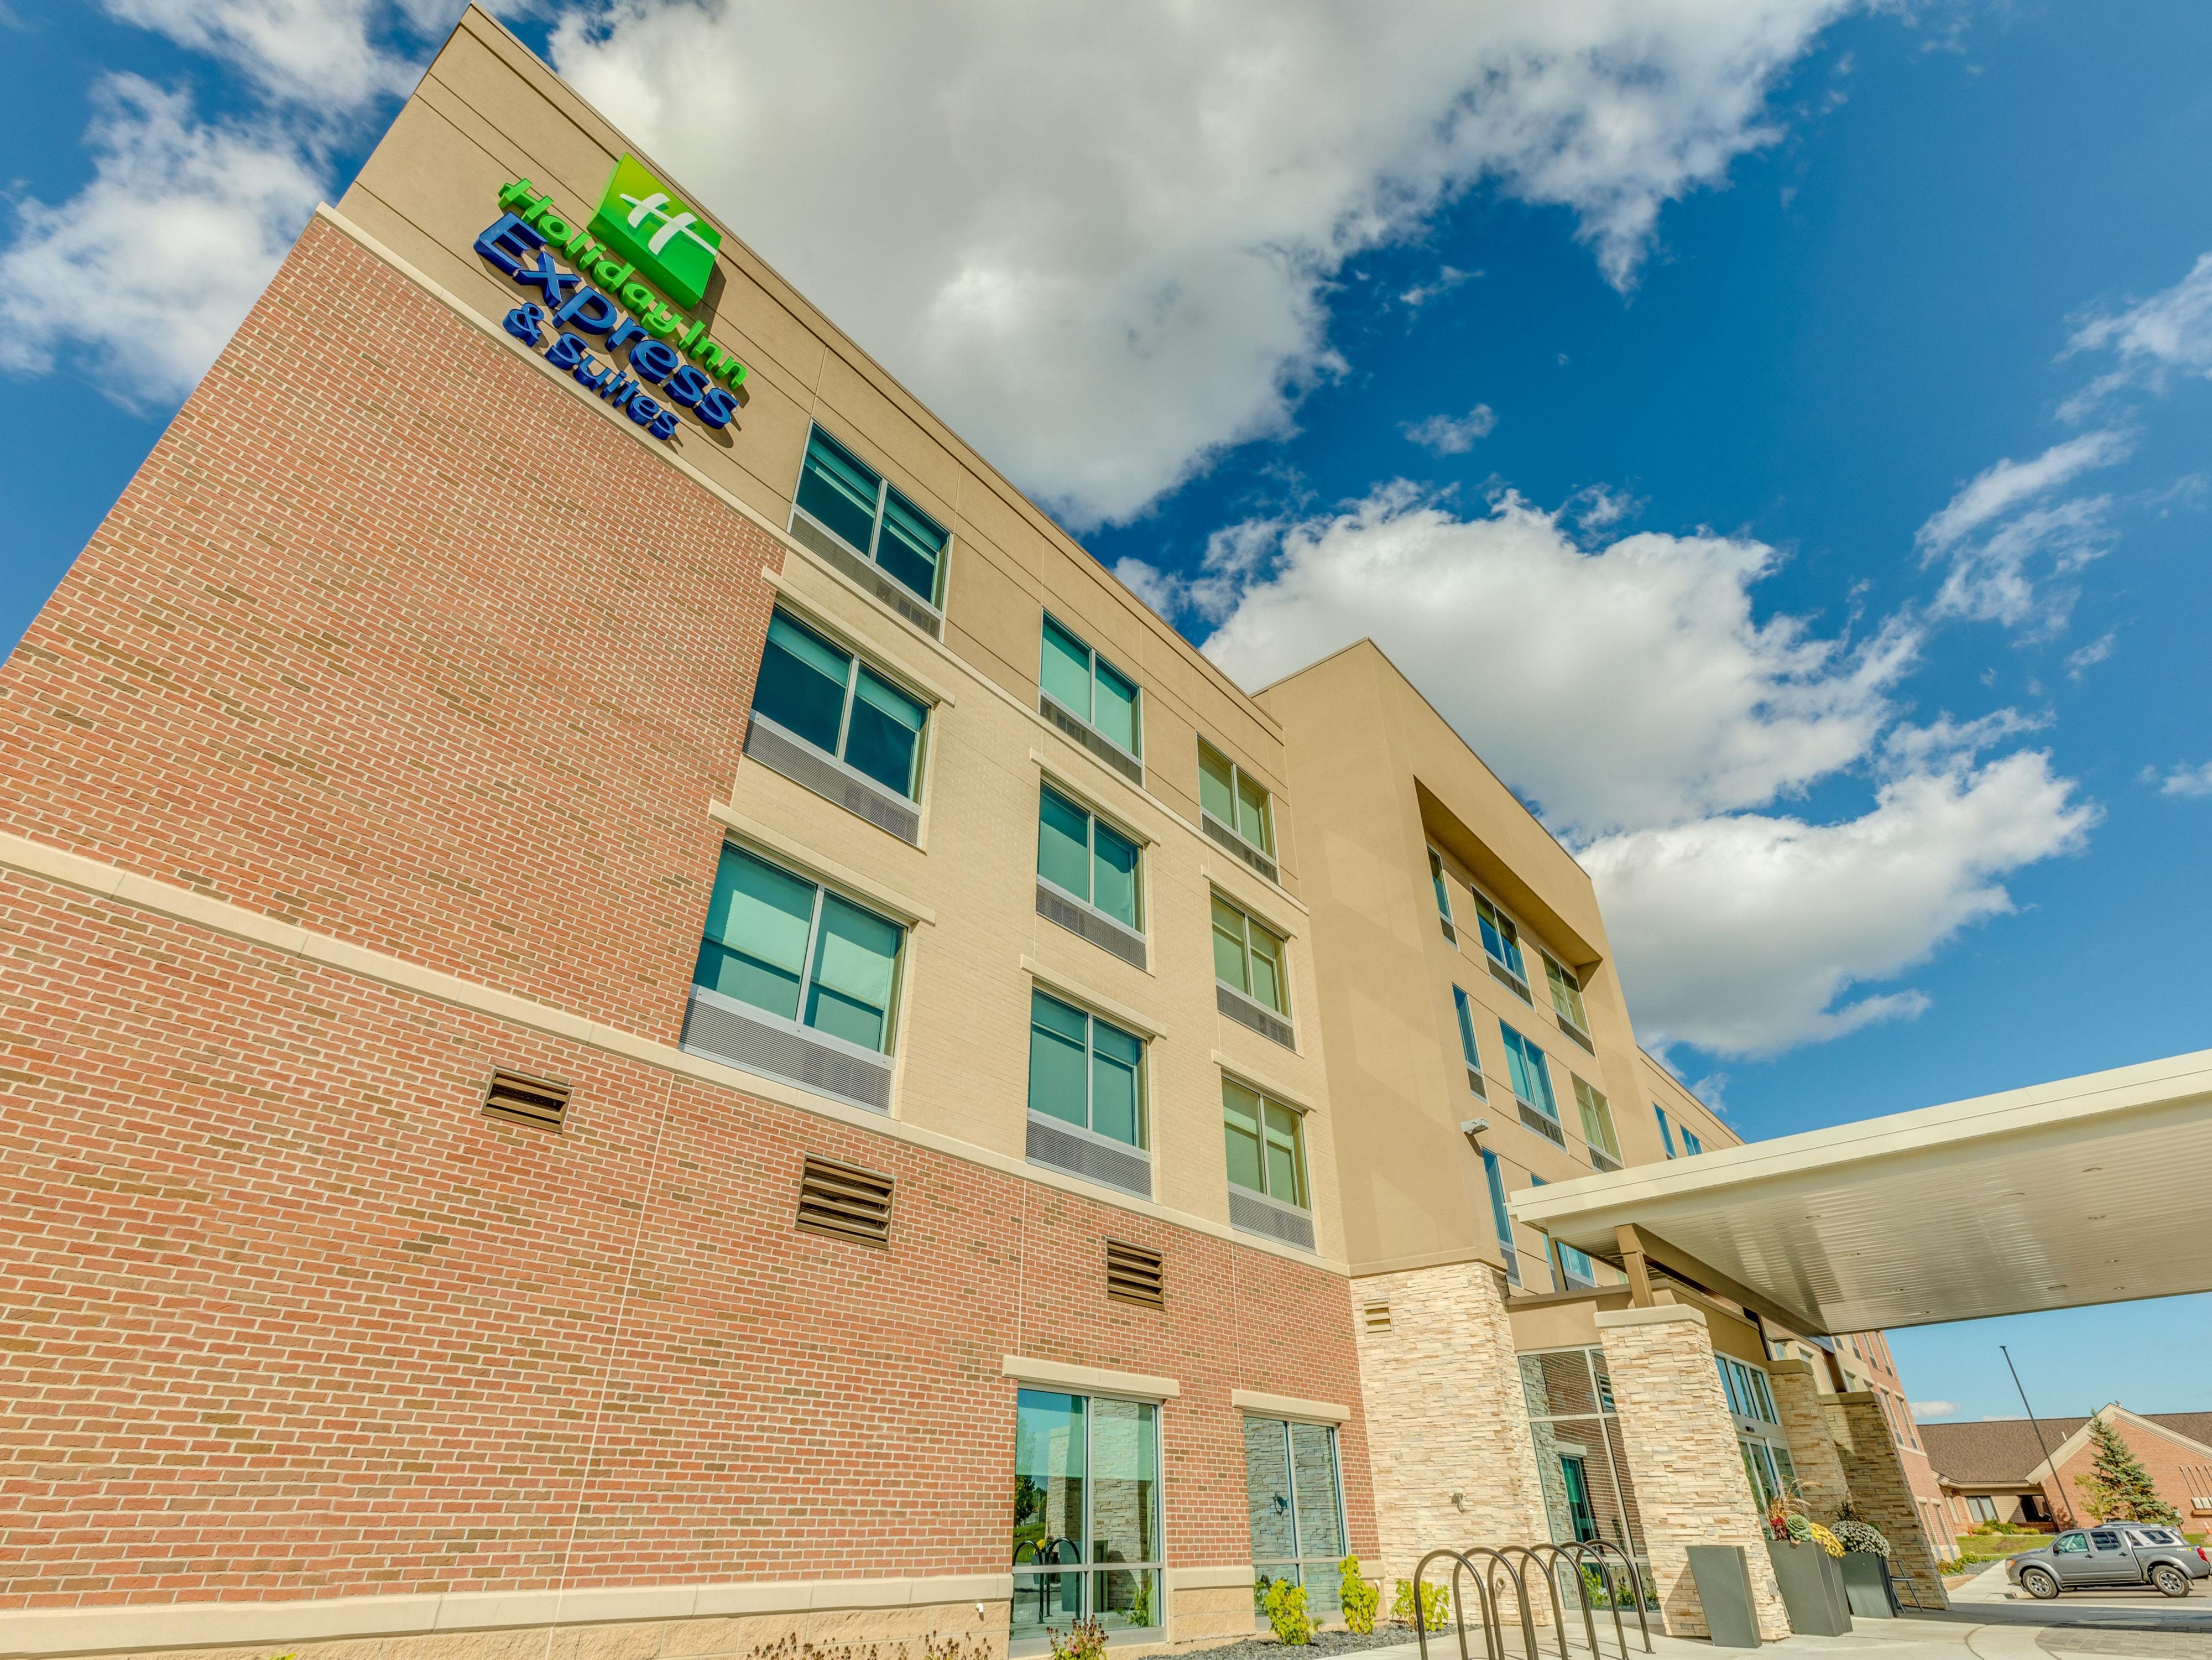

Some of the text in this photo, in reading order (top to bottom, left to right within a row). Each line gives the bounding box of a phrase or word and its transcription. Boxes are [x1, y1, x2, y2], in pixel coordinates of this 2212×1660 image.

[473, 211, 739, 429] Express
[498, 178, 748, 391] Holiday Inn
[503, 302, 680, 440] & Suites
